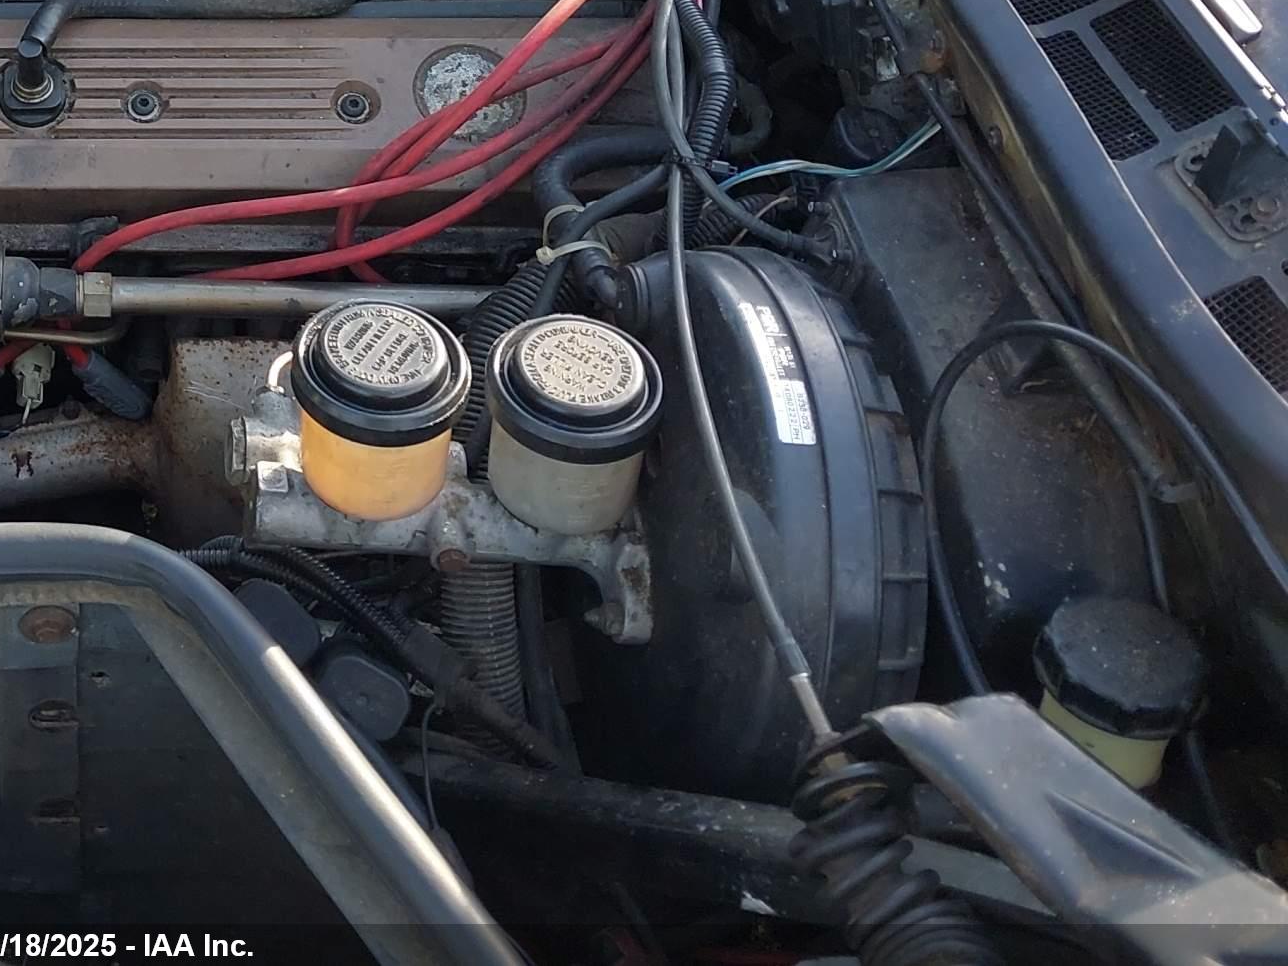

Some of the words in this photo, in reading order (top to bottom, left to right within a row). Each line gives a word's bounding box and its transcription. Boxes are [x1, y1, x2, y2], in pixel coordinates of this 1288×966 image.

[540, 349, 572, 371] FILLER
[554, 340, 592, 364] BEFORE
[567, 335, 615, 364] REMOVING
[543, 364, 585, 392] WARNING
[573, 368, 607, 389] CLEAN
[592, 362, 613, 376] CAP
